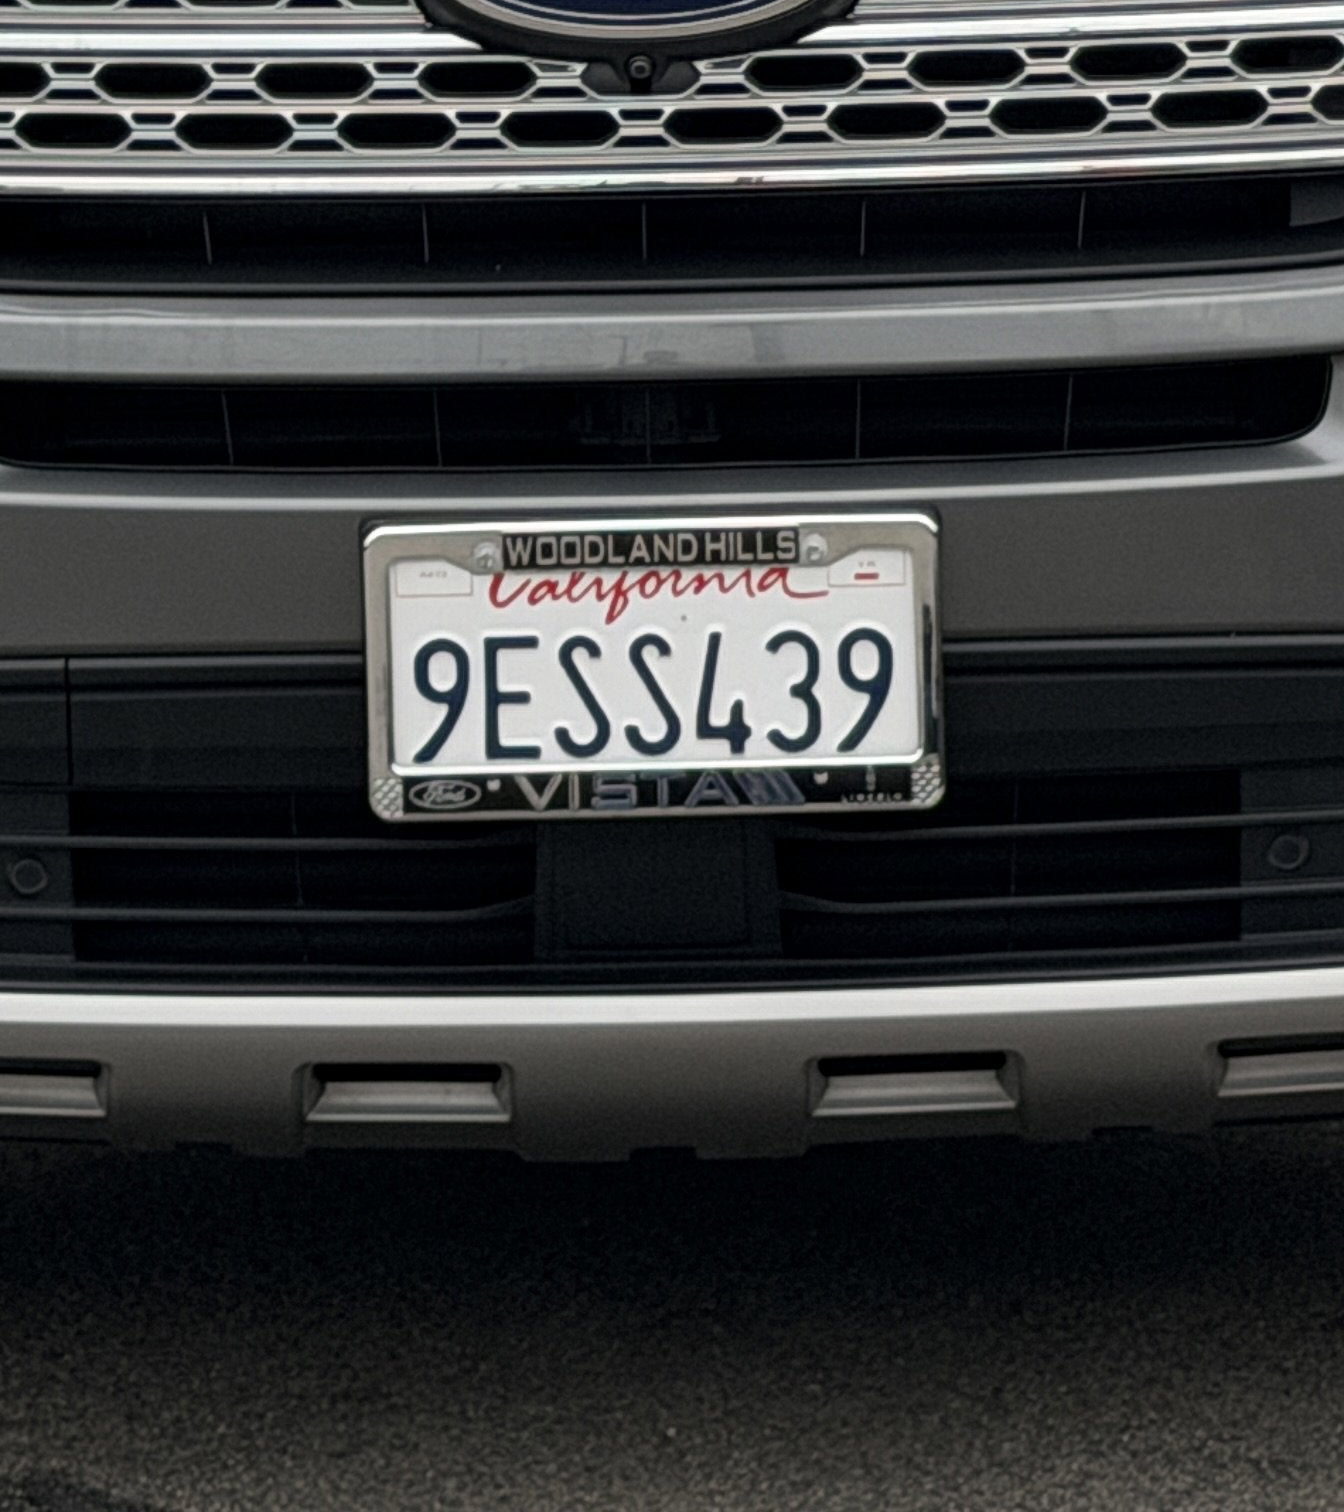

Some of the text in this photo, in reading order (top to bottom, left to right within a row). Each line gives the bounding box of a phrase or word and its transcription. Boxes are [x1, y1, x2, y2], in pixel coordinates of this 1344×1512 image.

[505, 529, 797, 567] WOODLAND HILLS
[487, 566, 830, 626] California
[411, 625, 895, 765] 9ESS439
[513, 769, 740, 811] VISTA
